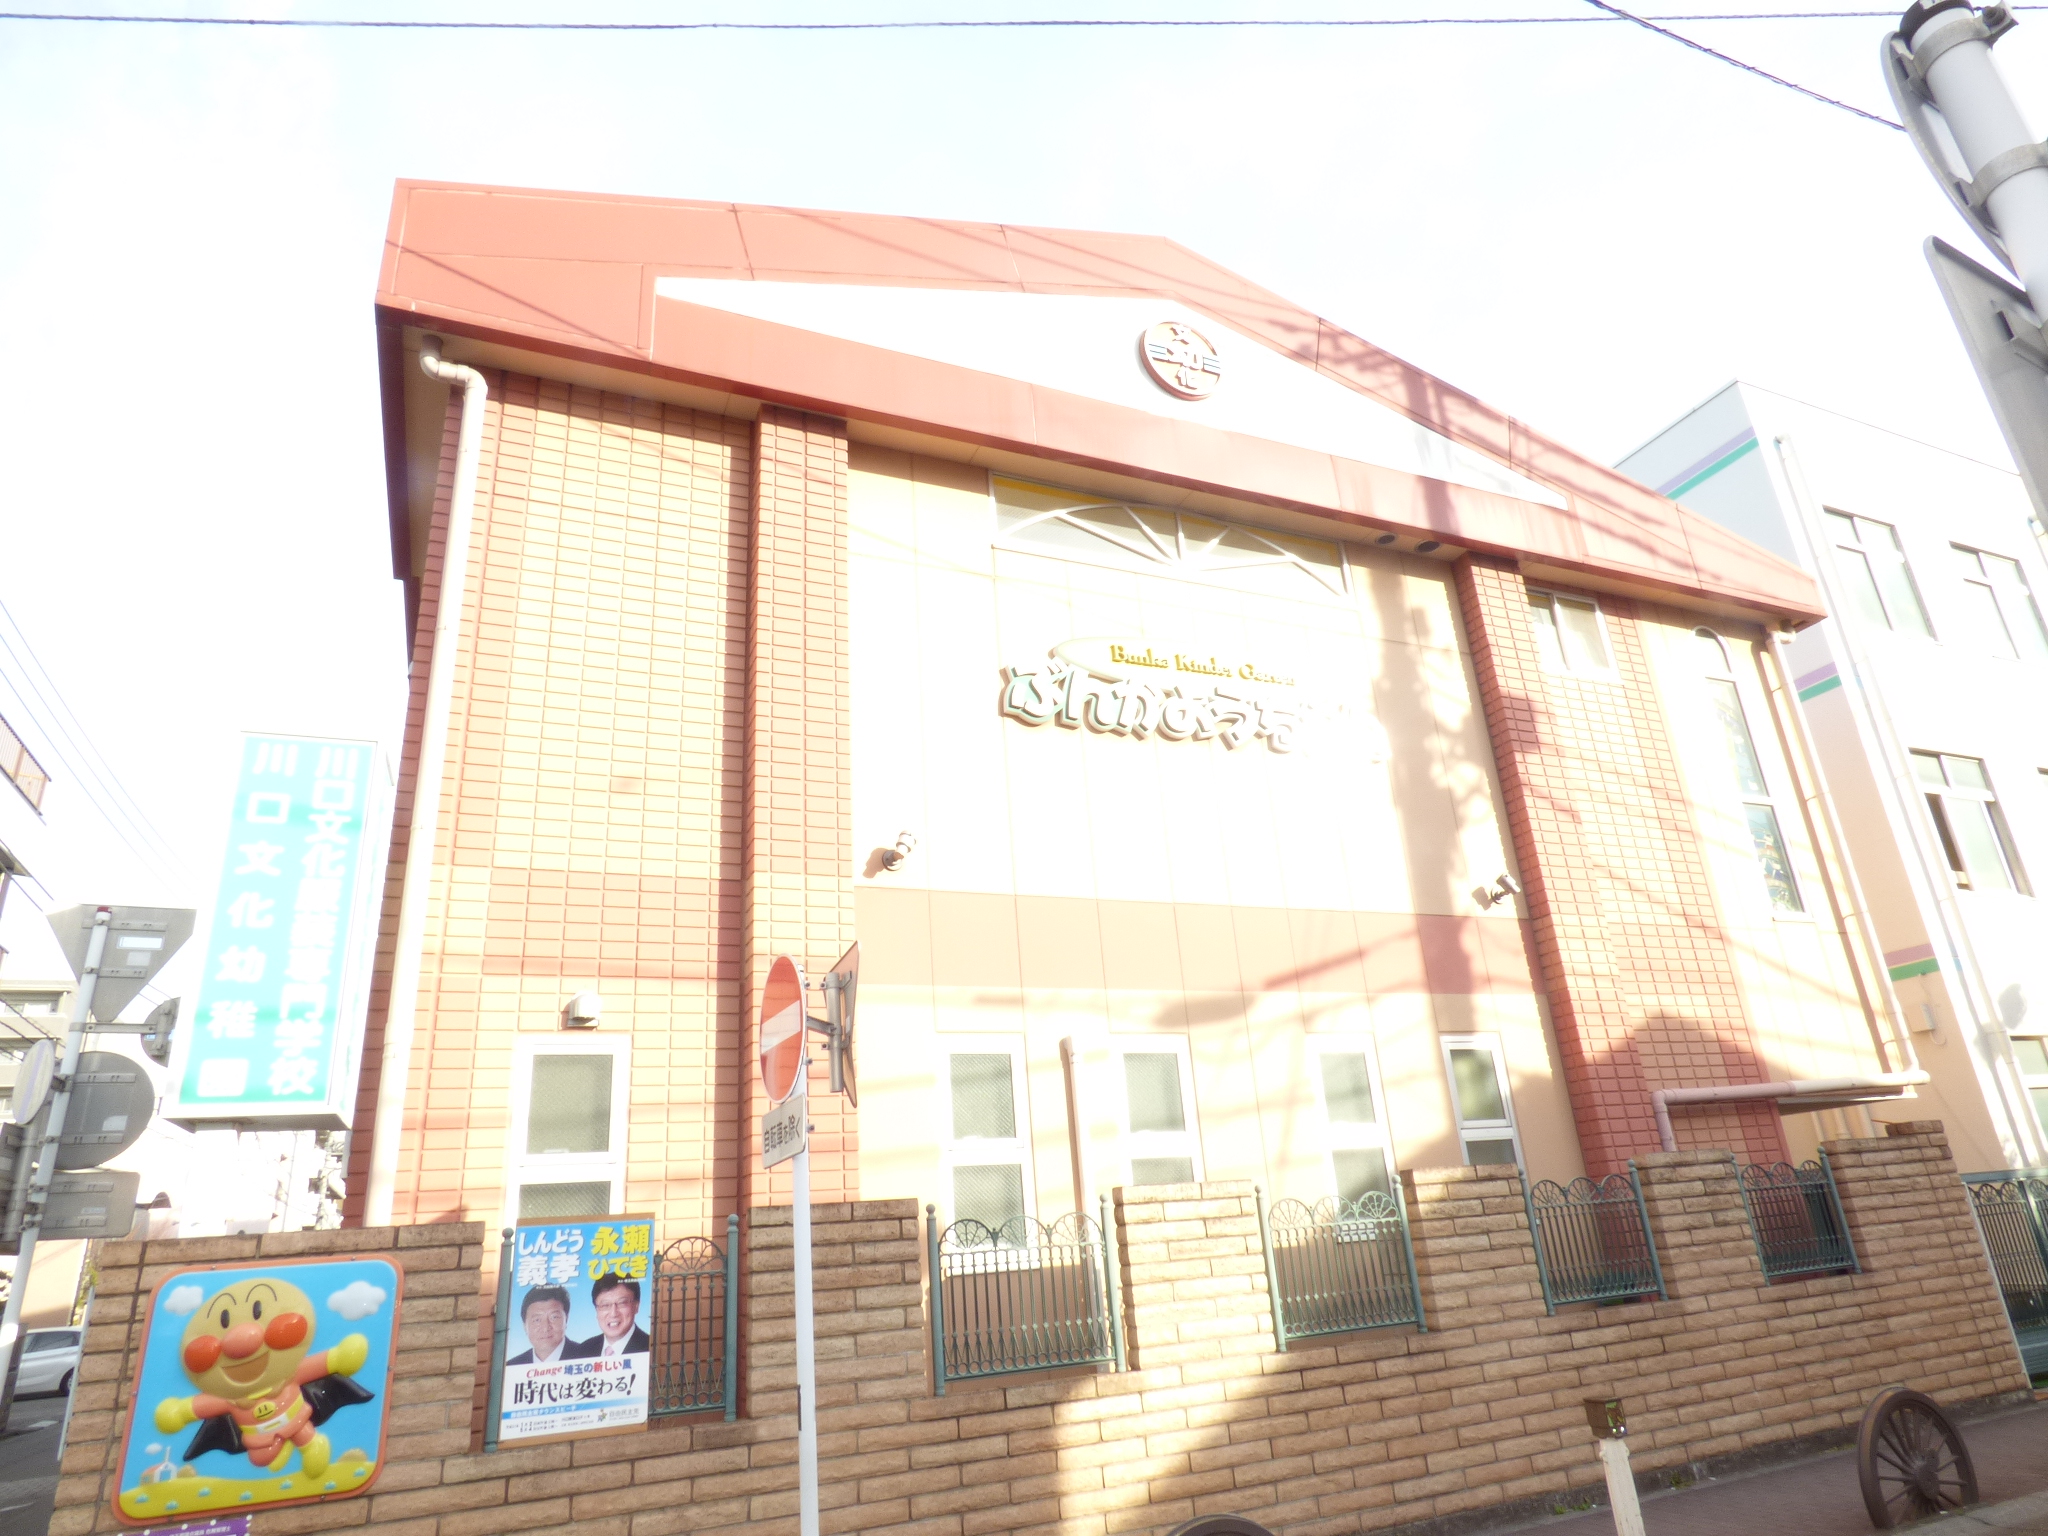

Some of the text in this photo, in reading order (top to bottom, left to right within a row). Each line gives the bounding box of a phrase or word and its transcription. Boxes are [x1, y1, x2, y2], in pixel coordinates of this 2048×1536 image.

[764, 1114, 801, 1154] 自転車を除く
[518, 1228, 584, 1256] しんどう
[516, 1253, 581, 1287] 義孝
[587, 1254, 649, 1281] ひでき
[526, 1358, 633, 1379] Change 埼玉の新しい風
